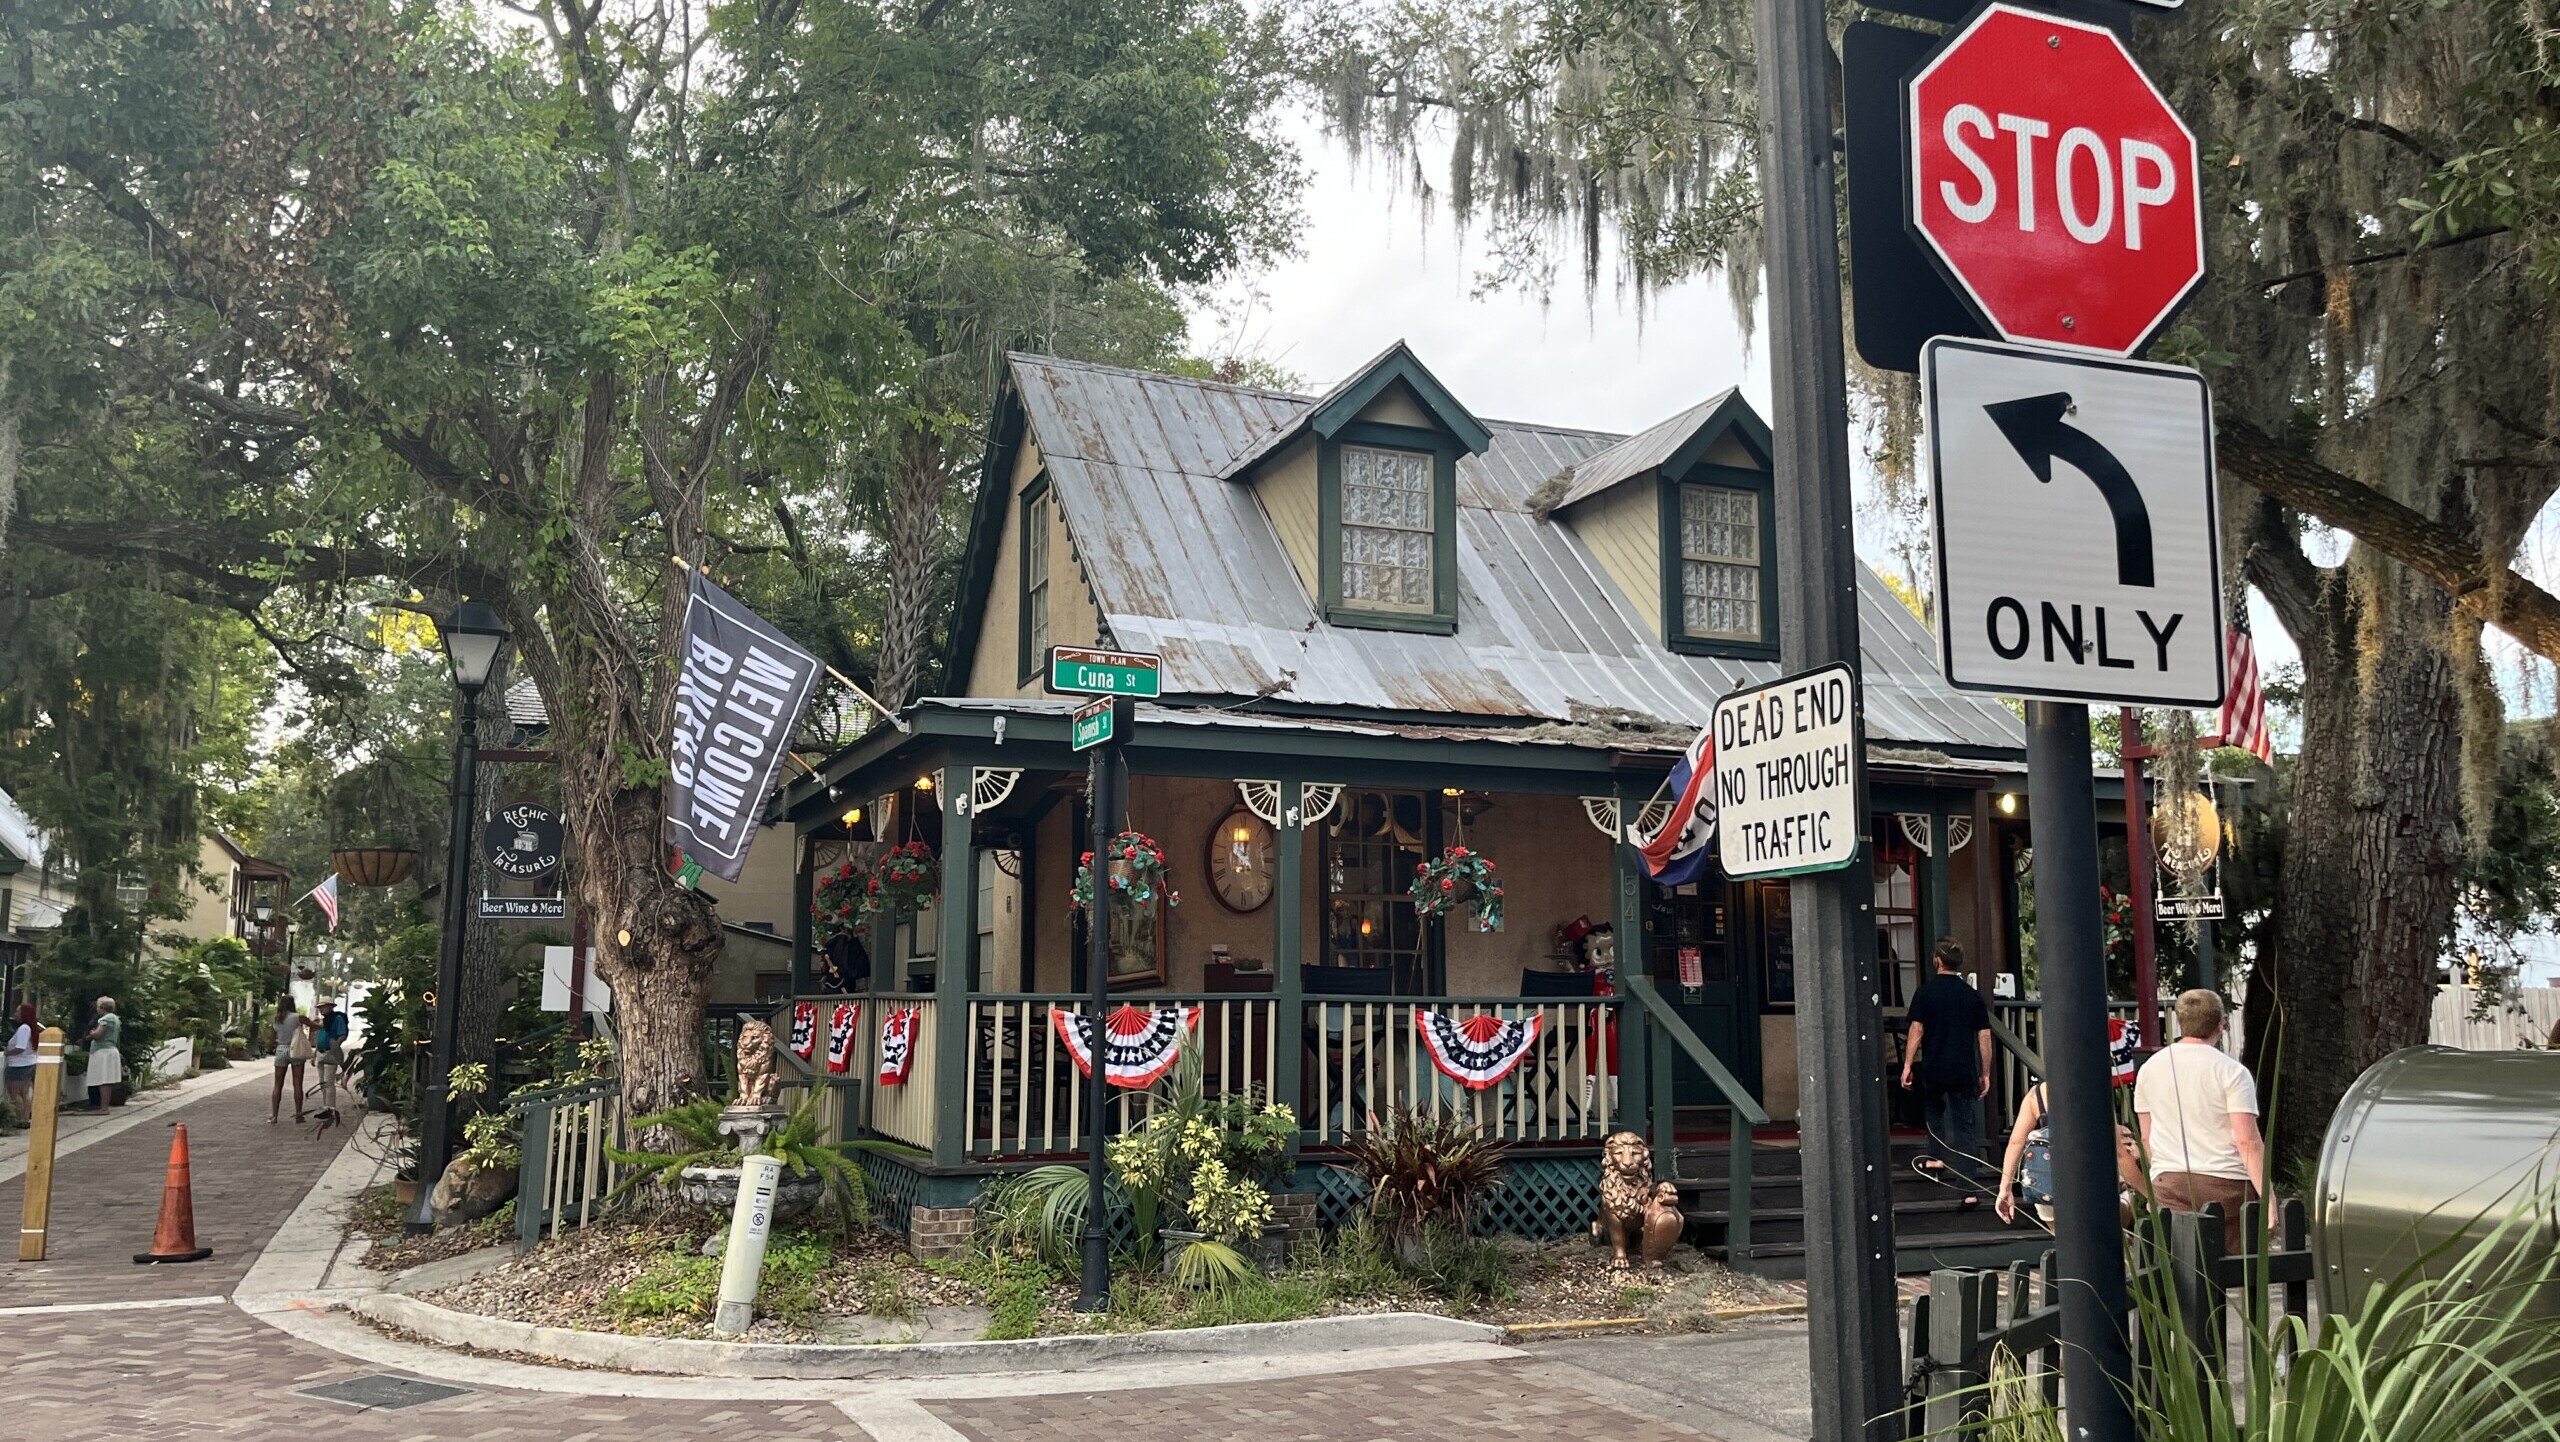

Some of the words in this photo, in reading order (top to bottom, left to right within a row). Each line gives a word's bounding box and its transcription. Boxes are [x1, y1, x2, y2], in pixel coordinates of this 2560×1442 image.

[1939, 103, 2176, 251] STOP
[1986, 596, 2184, 672] ONLY
[1078, 666, 1114, 689] Cuna
[1126, 674, 1136, 687] St
[1089, 654, 1105, 664] TOWN
[1110, 656, 1127, 666] PLAN
[1078, 716, 1099, 744] Spanish
[1102, 715, 1107, 729] St
[1721, 695, 1784, 751] DEAD
[1794, 678, 1844, 733] END
[1721, 767, 1746, 808] NO
[1756, 743, 1849, 801] THROUGH
[1742, 810, 1832, 862] TRAFFIC
[493, 846, 555, 873] TREASURE
[482, 902, 504, 913] Beer
[505, 902, 529, 914] Wine
[531, 902, 538, 913] &
[540, 903, 562, 913] More
[1624, 875, 1637, 922] 54
[2157, 903, 2175, 915] Beer
[2202, 902, 2221, 914] More
